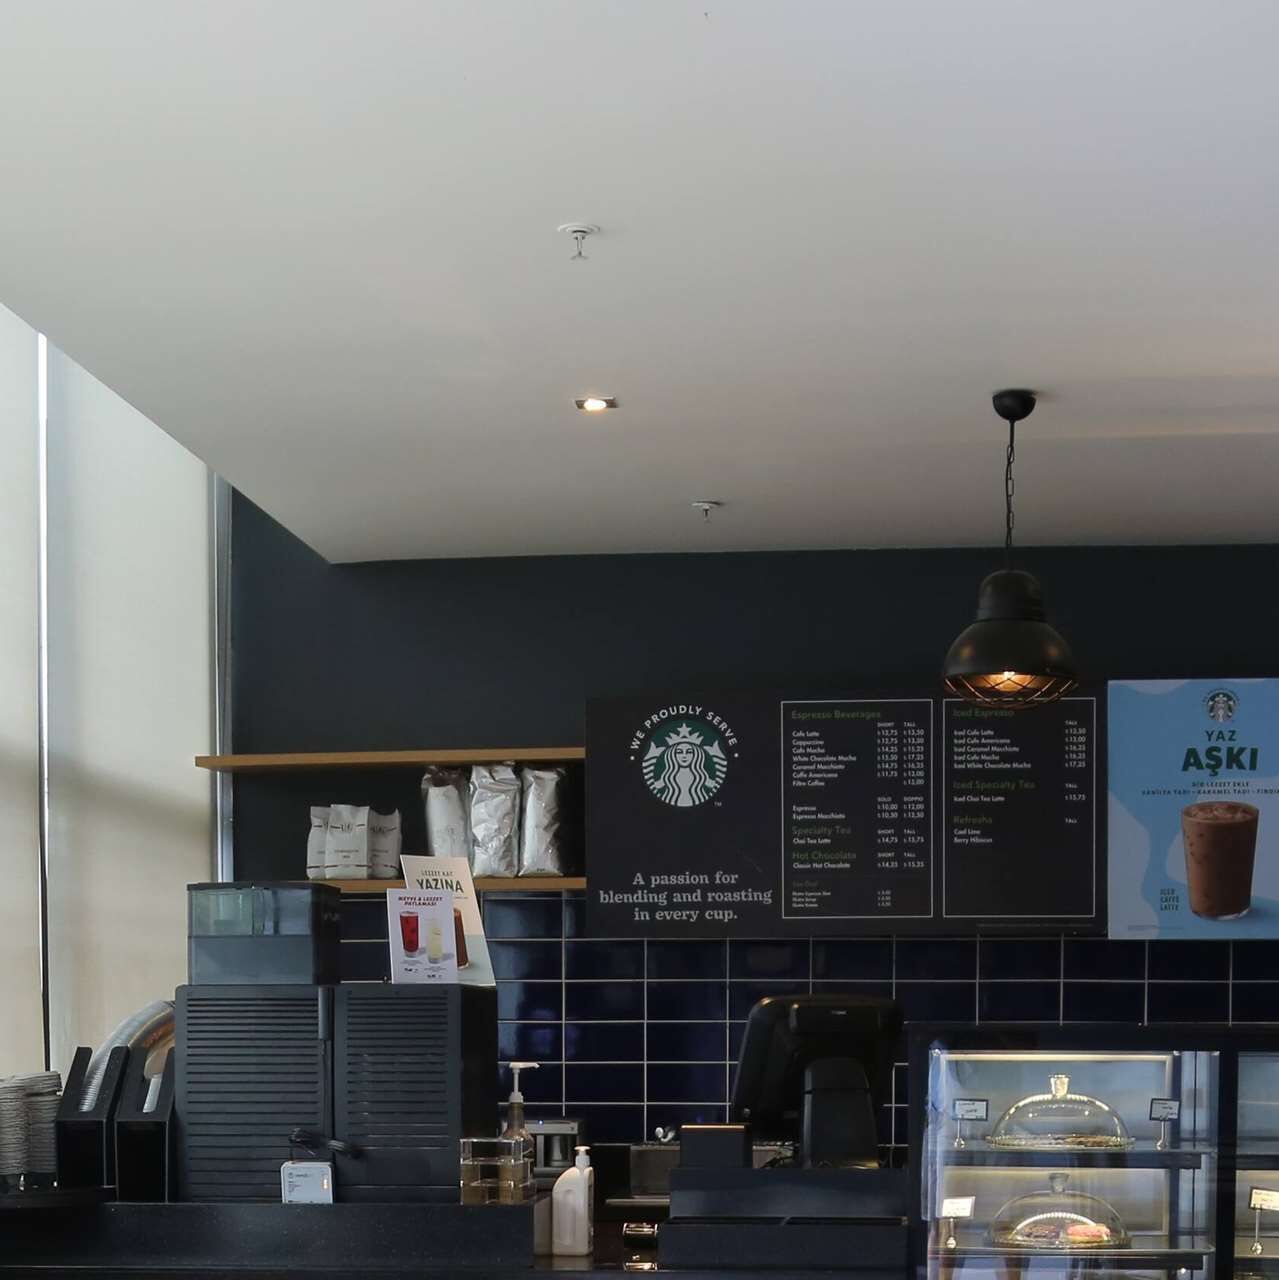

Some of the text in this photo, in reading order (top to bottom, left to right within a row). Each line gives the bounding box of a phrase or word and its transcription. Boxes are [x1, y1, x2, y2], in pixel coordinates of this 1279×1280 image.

[792, 710, 881, 720] Espresso Beverages
[630, 705, 738, 750] WE PROUDLY SERVE
[1205, 729, 1237, 742] YAZ
[1181, 746, 1259, 777] AŞKI
[416, 879, 464, 893] YAZINA
[632, 870, 739, 888] A passion for
[599, 888, 773, 905] blending and roasting
[634, 907, 738, 922] in every cup.
